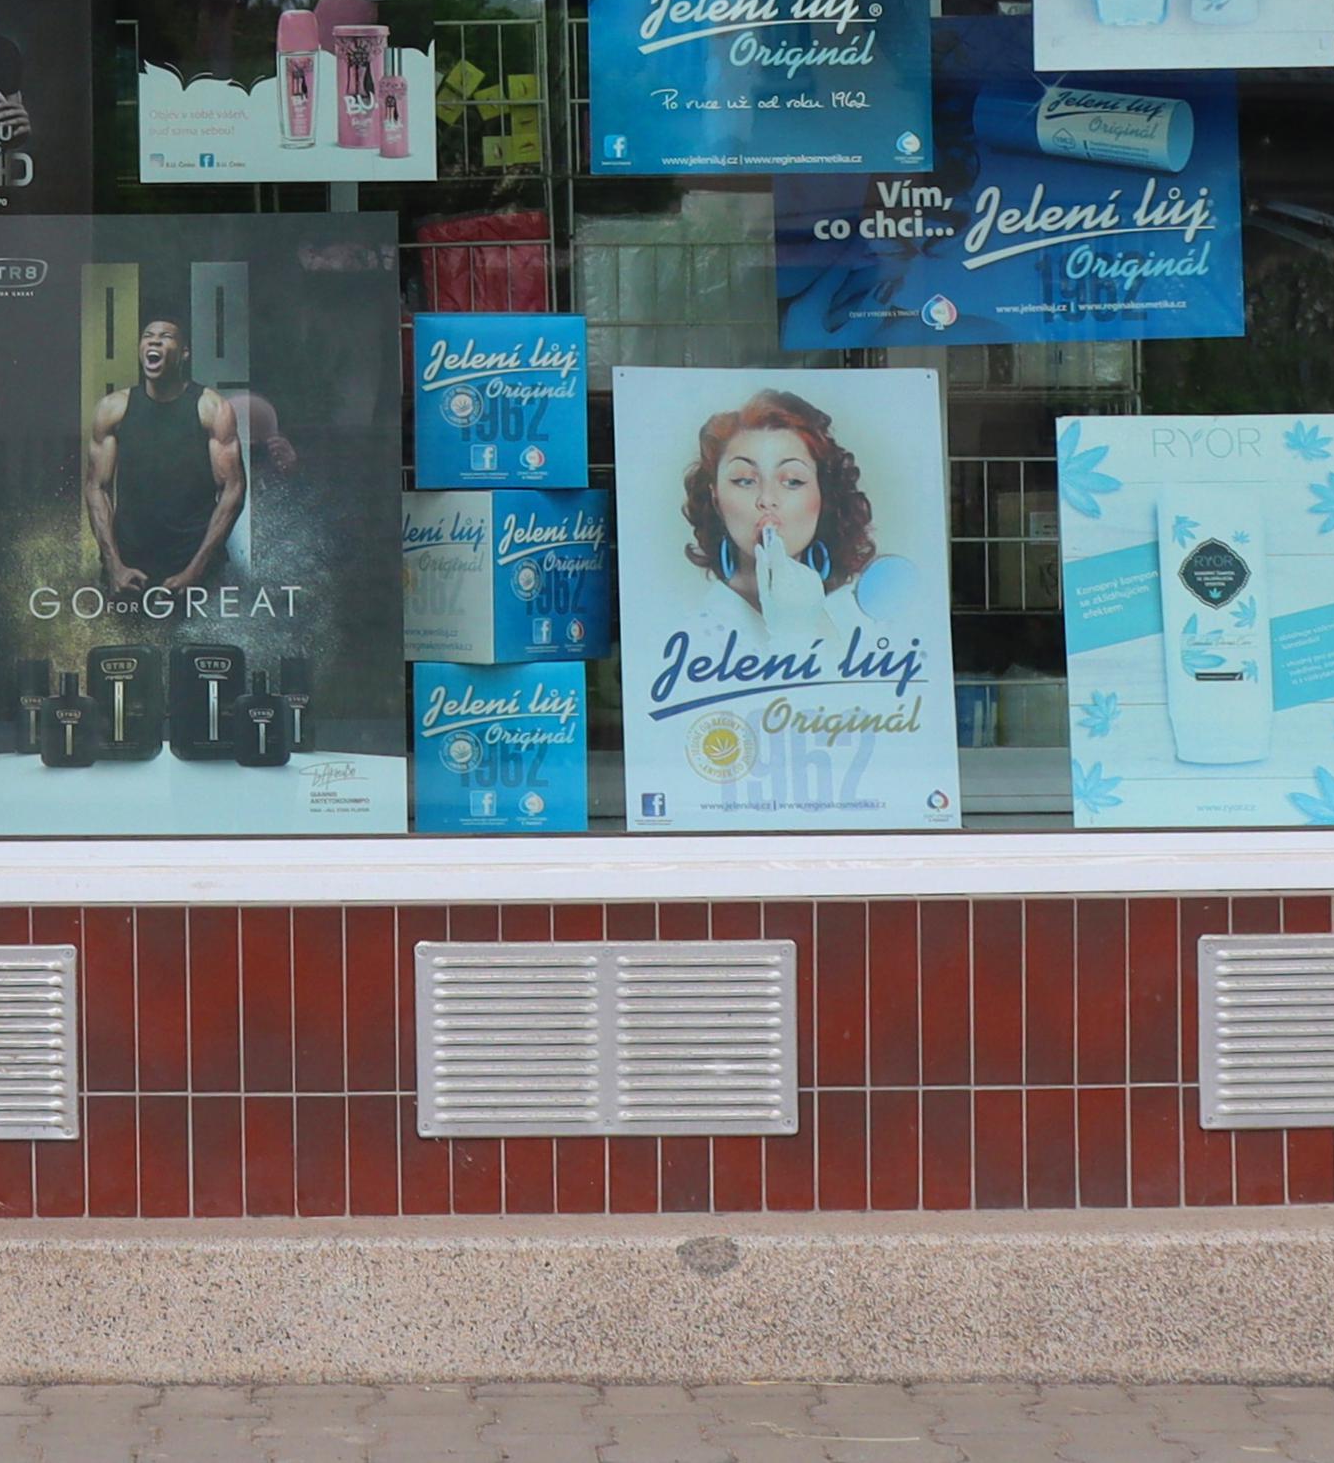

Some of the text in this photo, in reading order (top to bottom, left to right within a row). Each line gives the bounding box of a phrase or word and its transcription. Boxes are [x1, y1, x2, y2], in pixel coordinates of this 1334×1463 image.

[730, 30, 876, 79] Originál
[651, 89, 678, 111] Po
[685, 99, 721, 110] ruce
[758, 96, 781, 109] od
[786, 95, 824, 109] roku
[831, 91, 870, 109] 1962
[1047, 90, 1121, 112] Jelení
[1088, 115, 1159, 140] Originál
[661, 154, 862, 166] www.jeleniluj.cz www.reginakosmetika.cz
[876, 179, 954, 212] Vím,
[813, 209, 955, 240] co chci...
[964, 178, 1214, 253] Jelení lůj
[1066, 240, 1211, 291] Originál
[995, 302, 1067, 314] www.jeleniluj.cz
[423, 337, 578, 382] Jelení lůj
[485, 375, 577, 407] Originál
[460, 383, 549, 442] 962
[1152, 426, 1262, 459] RYOR
[403, 511, 486, 552] lení lůj
[498, 510, 606, 555] Jelení lůj
[418, 551, 485, 578] Originál
[542, 550, 605, 579] Originál
[1194, 555, 1234, 567] RYOR
[28, 586, 302, 620] GO FOR GREAT
[526, 557, 588, 616] 962
[648, 626, 923, 703] Jelení lůj
[422, 683, 577, 727] Jelení lůj
[484, 722, 576, 752] Originál
[761, 696, 923, 748] Originál
[460, 728, 549, 787] 962
[720, 707, 882, 812] 962
[699, 800, 772, 811] www.jeleniluj.cz
